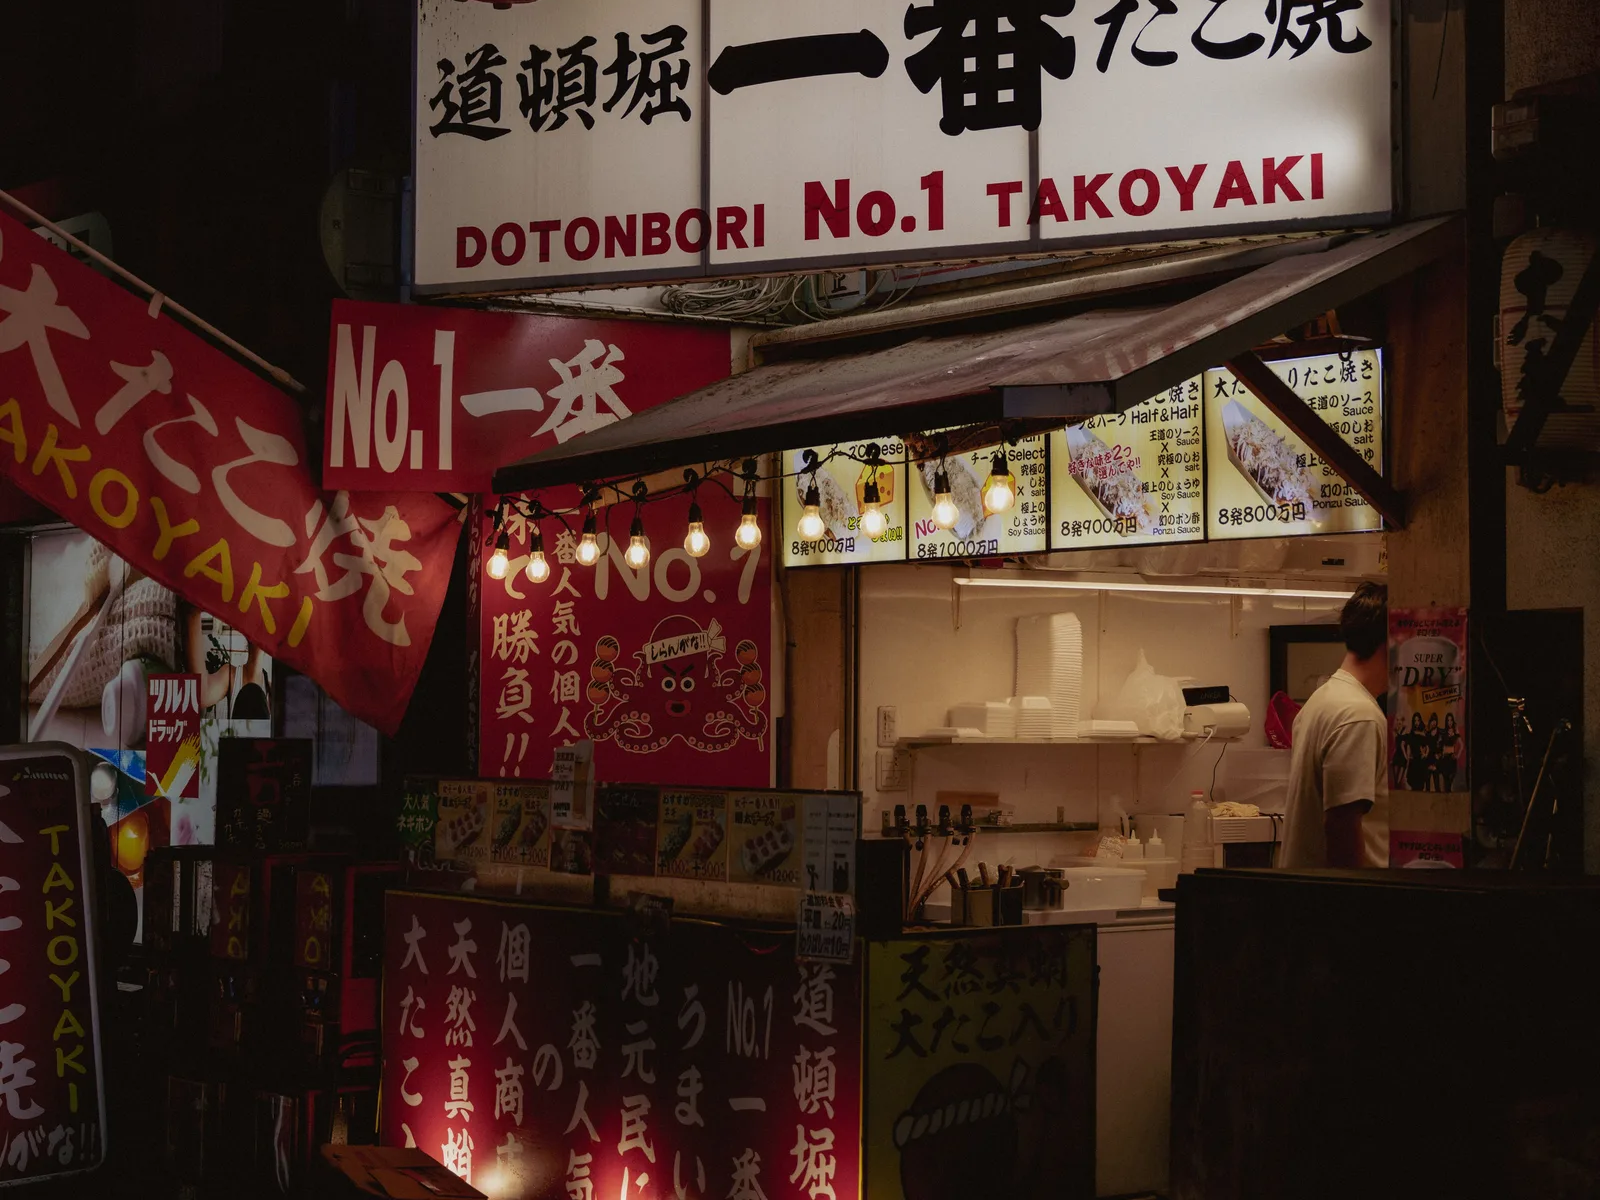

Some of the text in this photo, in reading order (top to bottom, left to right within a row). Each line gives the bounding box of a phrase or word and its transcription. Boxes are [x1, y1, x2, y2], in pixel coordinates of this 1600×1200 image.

[456, 152, 1325, 269] DOTONBORI No.1 TAKOYAKI
[1131, 404, 1200, 425] Half&Half
[1338, 405, 1374, 417] Sauce
[1149, 426, 1200, 442] 王道のソース
[1354, 435, 1375, 445] salt
[1176, 438, 1200, 447] Sauce
[1008, 447, 1046, 462] Select
[1068, 444, 1132, 475] 好きな味を2つ
[1157, 452, 1200, 466] 究極のしお
[1021, 463, 1046, 476] 究極の
[1184, 463, 1200, 472] salt
[1029, 477, 1046, 488] しお
[1142, 478, 1200, 494] 極上のしょうゆ
[1030, 489, 1046, 497] salt
[1160, 489, 1201, 500] Soy Sauce
[1021, 502, 1046, 515] 極上の
[1312, 497, 1369, 510] Ponzu Sauc
[1013, 516, 1046, 528] しょうゆ
[1218, 502, 1306, 526] 8発800万円
[1008, 527, 1046, 538] Soy Sauce
[1061, 517, 1137, 538] 8発900万円
[1152, 525, 1201, 536] Ponzu Sauce
[791, 537, 855, 557] 8発900万円
[917, 539, 999, 559] 8発1000万円
[548, 505, 582, 755] 一番人気の個人
[1413, 652, 1443, 664] SUPER
[150, 679, 199, 714] ツルハ
[149, 719, 188, 743] ドラッグ
[403, 793, 430, 811] 大人気
[39, 824, 87, 1113] TAKOYAKI
[673, 982, 707, 1199] うまい
[789, 965, 839, 1200] 道頓堀
[0, 1123, 97, 1172] がな!!
